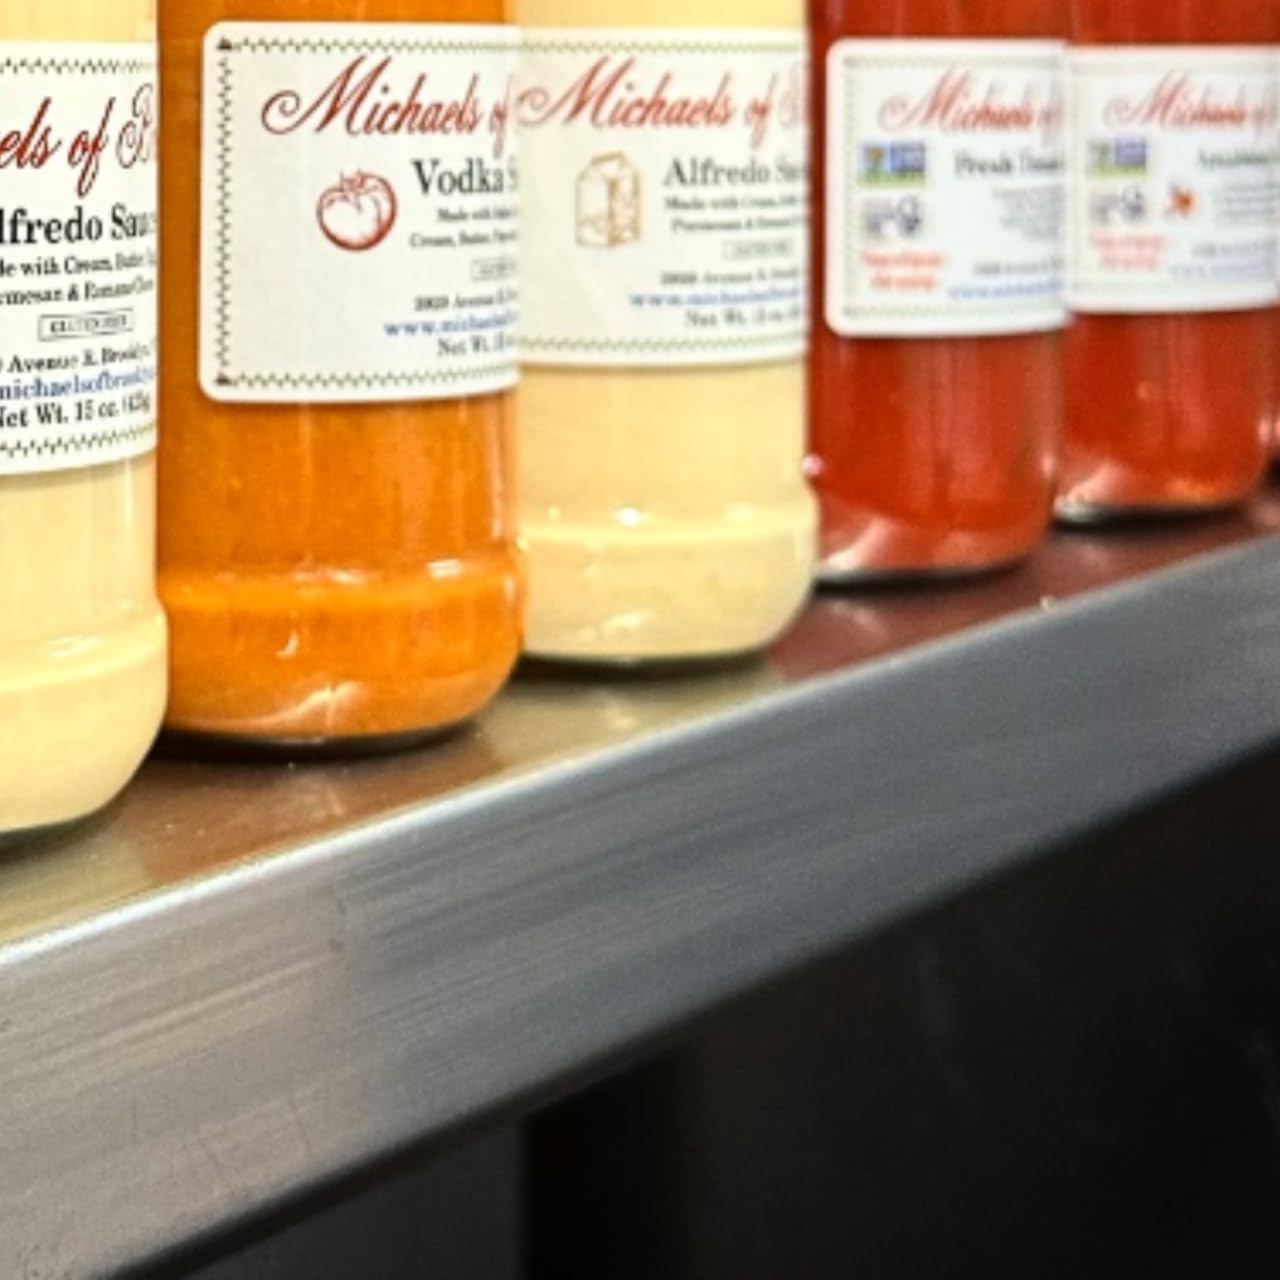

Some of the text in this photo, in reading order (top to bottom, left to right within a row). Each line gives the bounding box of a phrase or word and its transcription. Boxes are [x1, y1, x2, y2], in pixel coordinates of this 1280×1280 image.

[261, 54, 484, 135] Michaels
[515, 55, 734, 128] Michaels
[744, 73, 781, 150] of
[877, 67, 1033, 133] Michaels
[67, 96, 116, 197] of
[662, 156, 770, 187] Alfredo
[410, 157, 504, 195] Vodka
[20, 256, 60, 276] with
[35, 402, 69, 425] Wt.
[74, 399, 94, 422] 15
